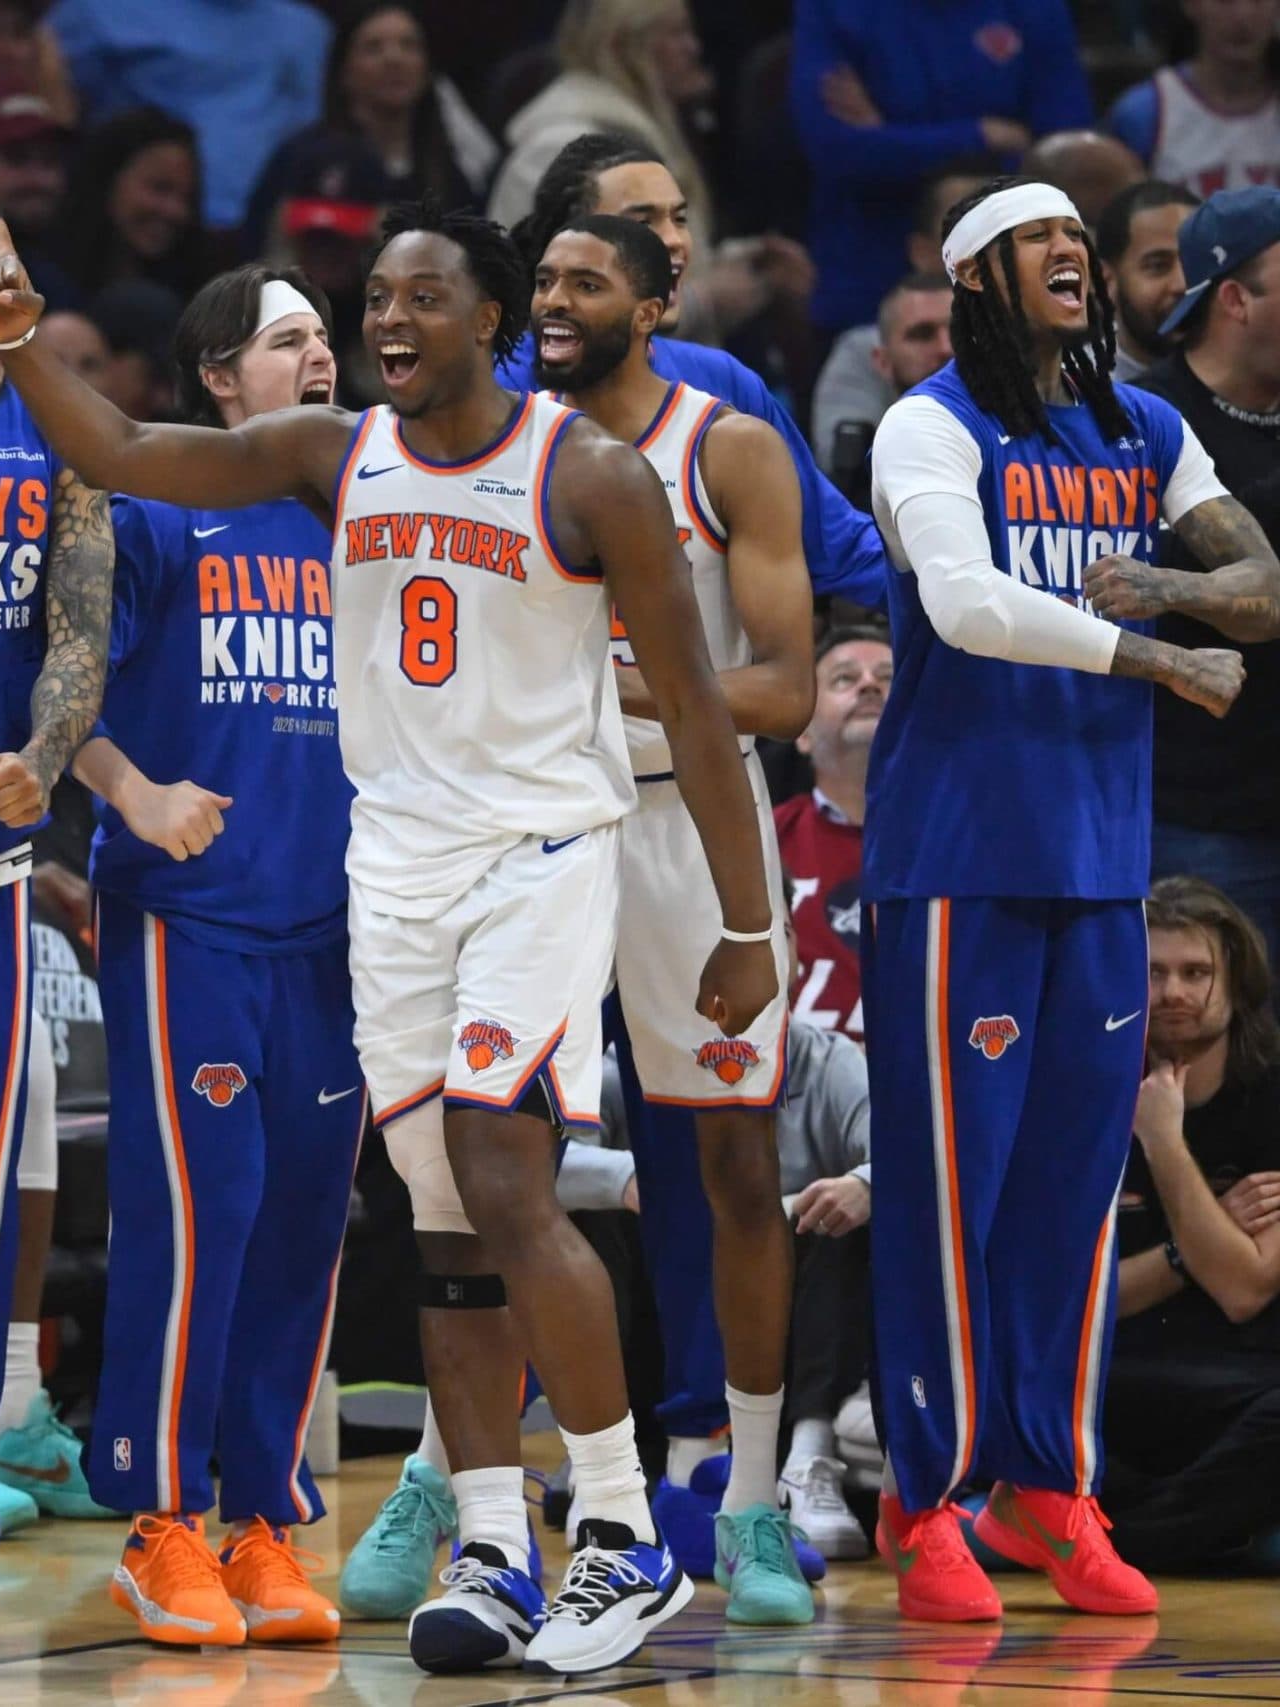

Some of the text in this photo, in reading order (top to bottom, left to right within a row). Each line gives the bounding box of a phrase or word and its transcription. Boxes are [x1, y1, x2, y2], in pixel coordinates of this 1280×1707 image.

[473, 483, 527, 497] abu dhabi
[1004, 462, 1158, 527] ALWAYS
[346, 513, 530, 583] NEW YORK
[1007, 525, 1153, 589] KNICK
[198, 554, 331, 617] ALWA
[200, 616, 336, 682] KNIC
[400, 575, 458, 688] 8
[201, 681, 246, 704] NEW
[251, 682, 313, 708] YRK
[272, 716, 295, 733] 2026
[458, 1021, 514, 1058] KNICKS
